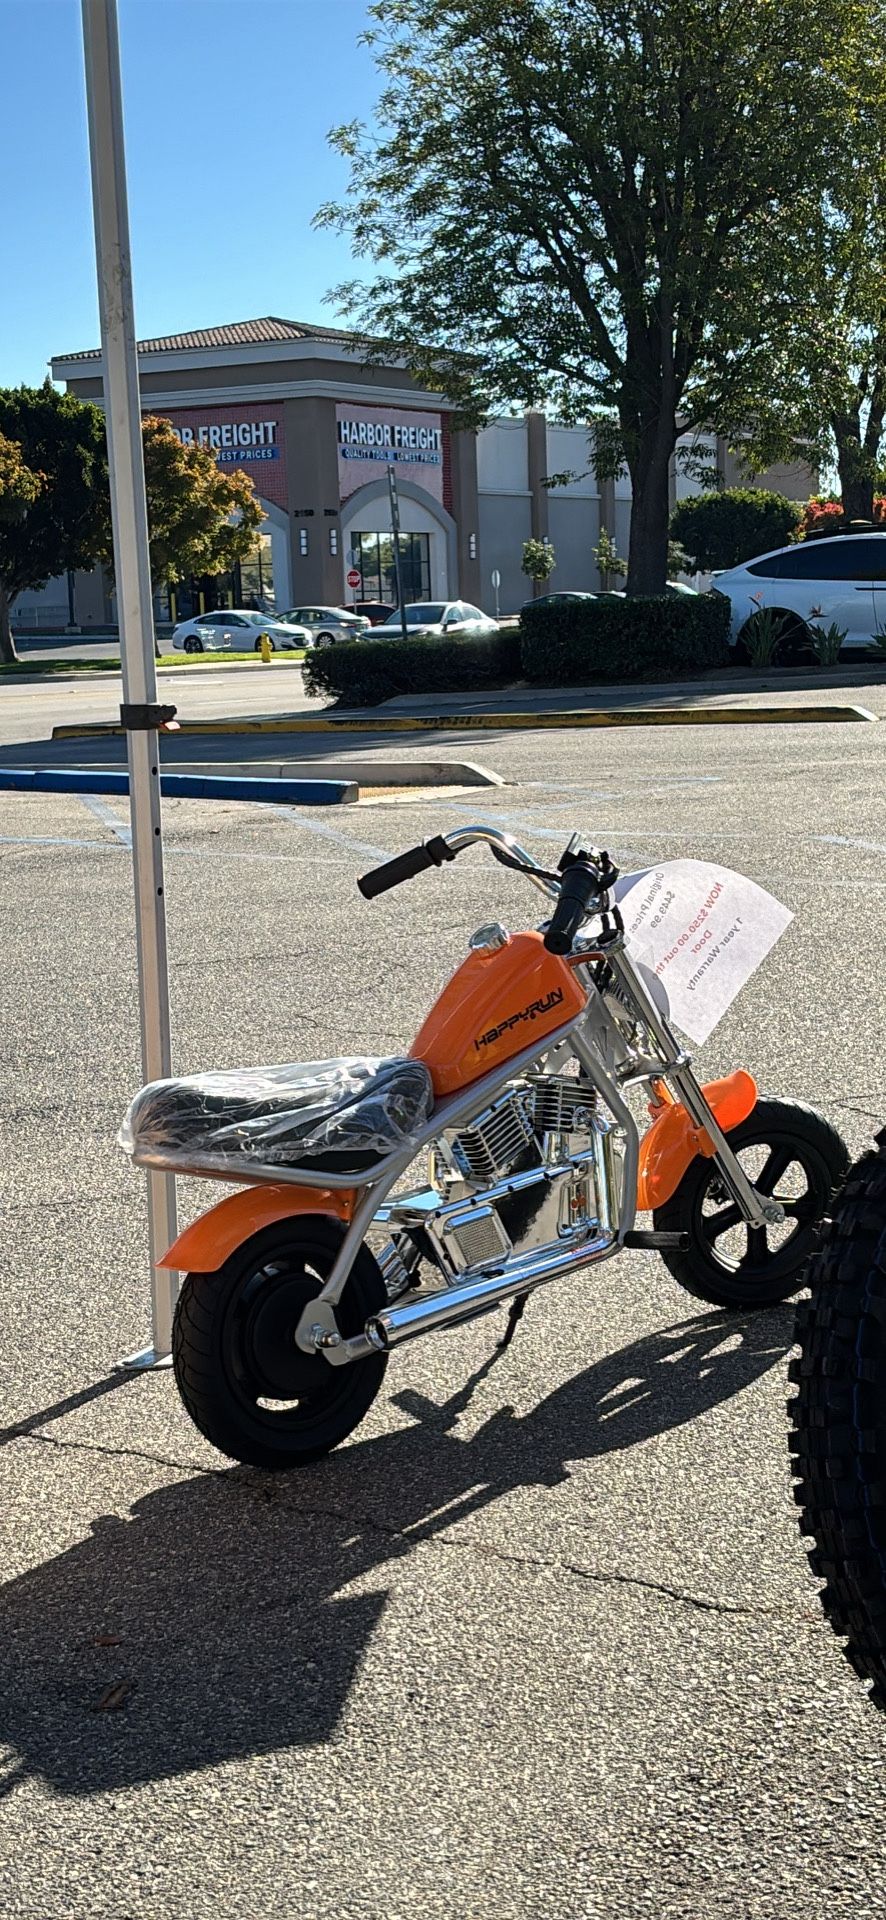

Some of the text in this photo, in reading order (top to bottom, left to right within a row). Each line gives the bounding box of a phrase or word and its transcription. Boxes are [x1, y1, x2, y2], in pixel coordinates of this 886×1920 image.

[198, 421, 277, 448] FREIGHT
[340, 420, 442, 449] HARBOR FREIGHT
[240, 449, 272, 460] PRICES
[344, 448, 370, 459] QUALITY
